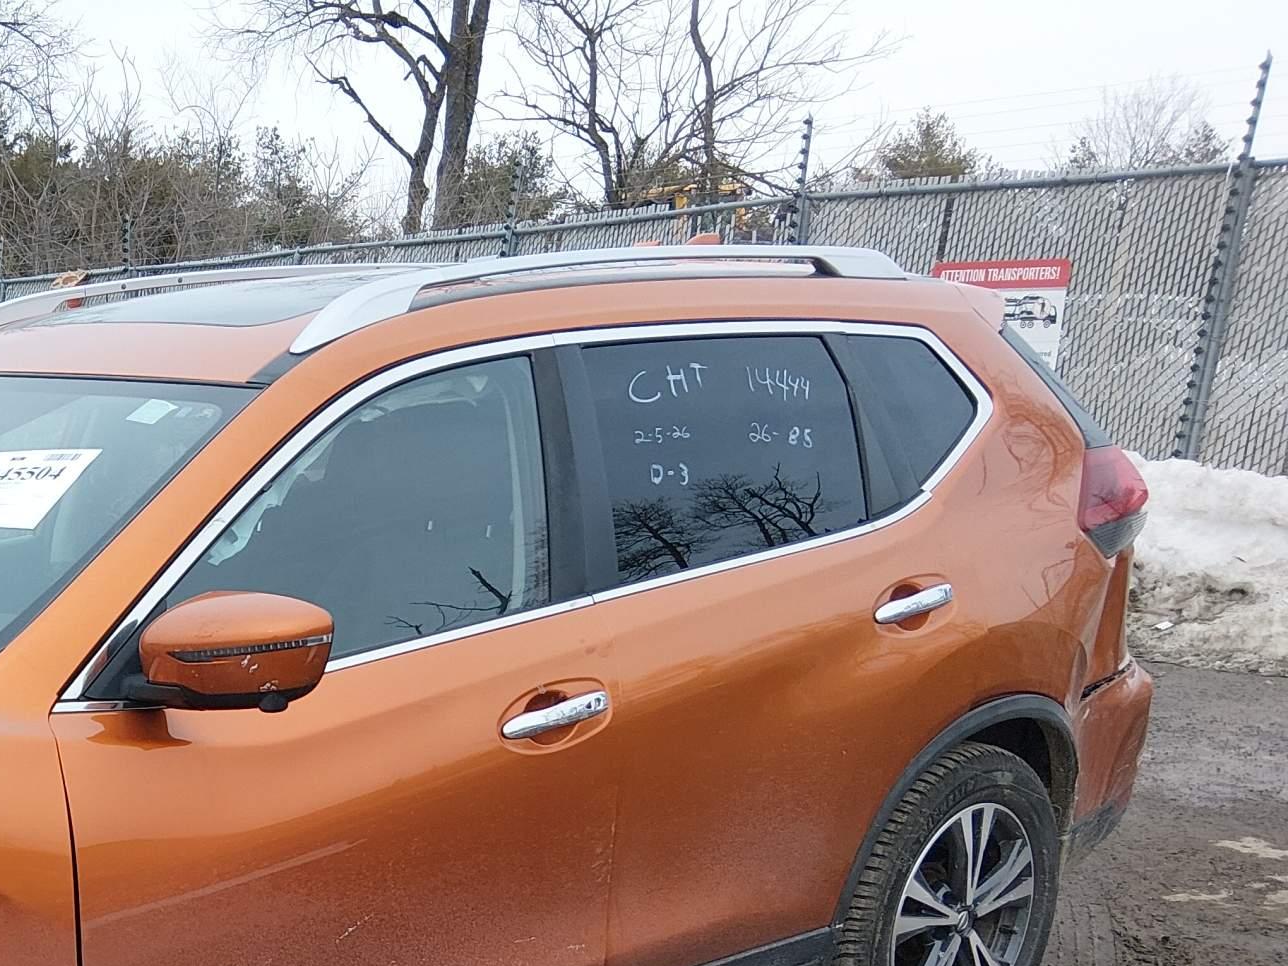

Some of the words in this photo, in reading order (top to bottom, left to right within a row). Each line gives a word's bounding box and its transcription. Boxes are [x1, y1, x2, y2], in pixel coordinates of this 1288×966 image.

[940, 269, 986, 282] ATTENTION
[988, 265, 1061, 282] TRANSPORTERS!
[634, 425, 691, 444] 2-5-26
